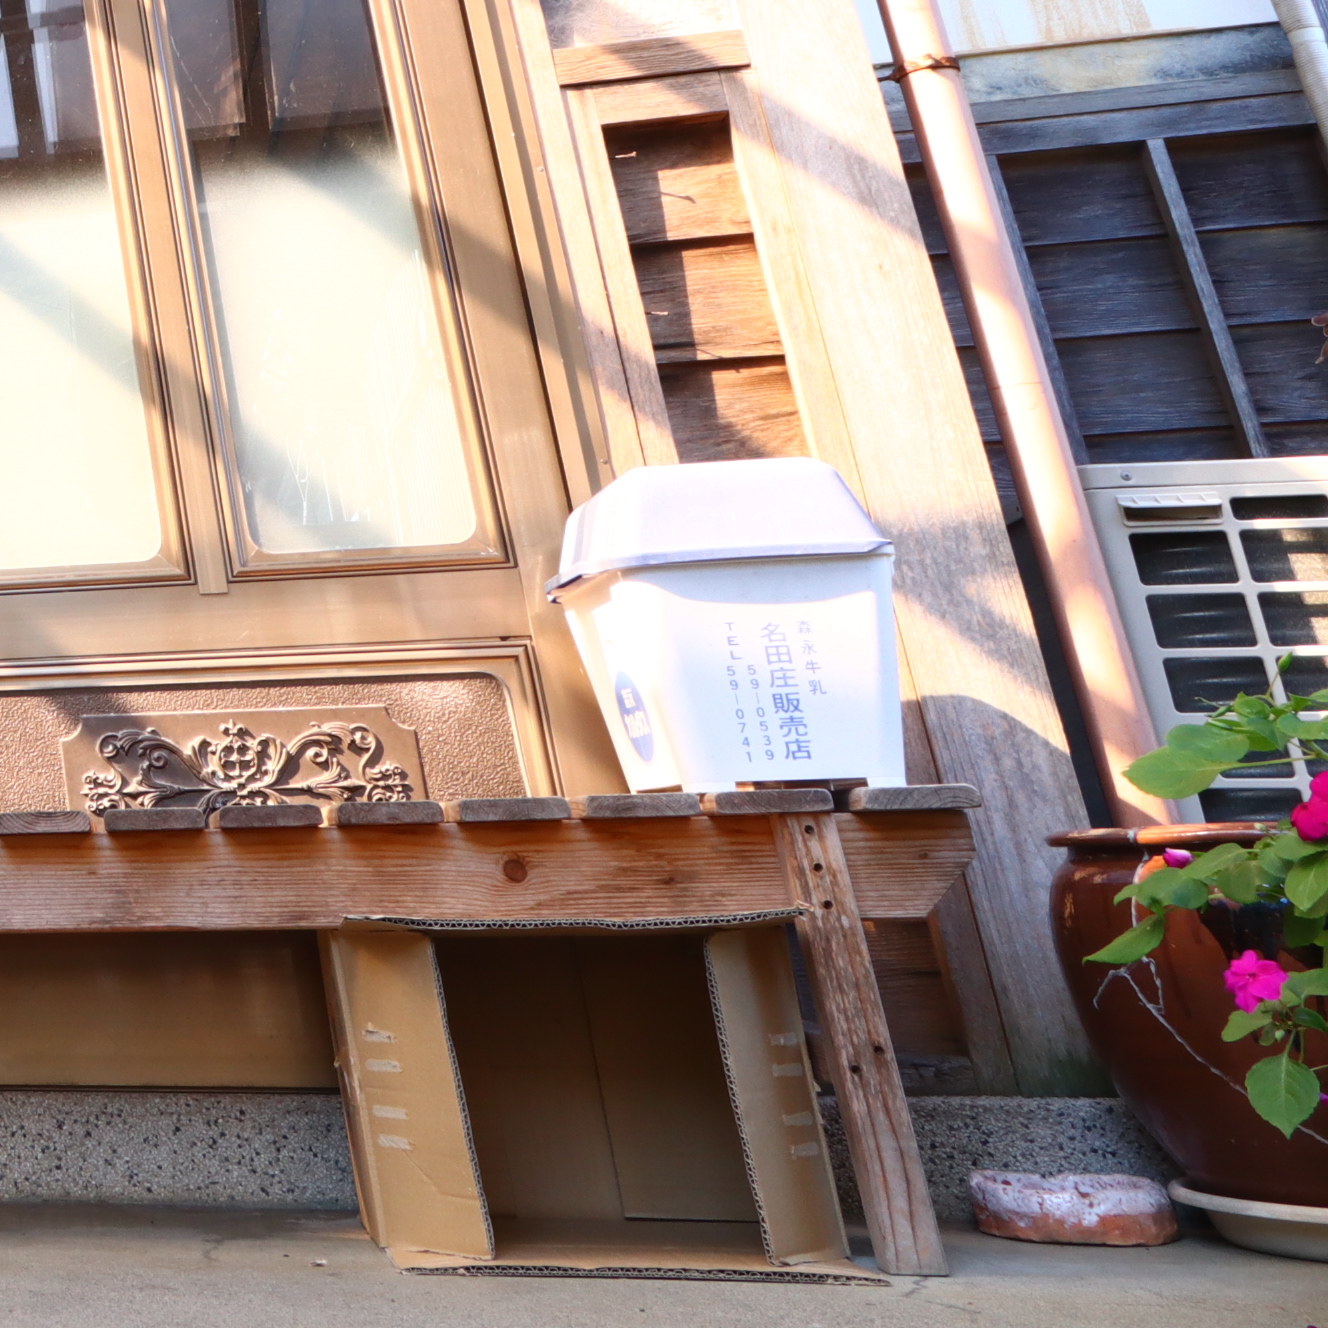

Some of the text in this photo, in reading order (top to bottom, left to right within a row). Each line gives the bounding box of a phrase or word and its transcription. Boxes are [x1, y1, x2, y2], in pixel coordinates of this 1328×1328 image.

[760, 622, 812, 761] 名田庄販売店
[796, 620, 828, 695] 森永牛乳
